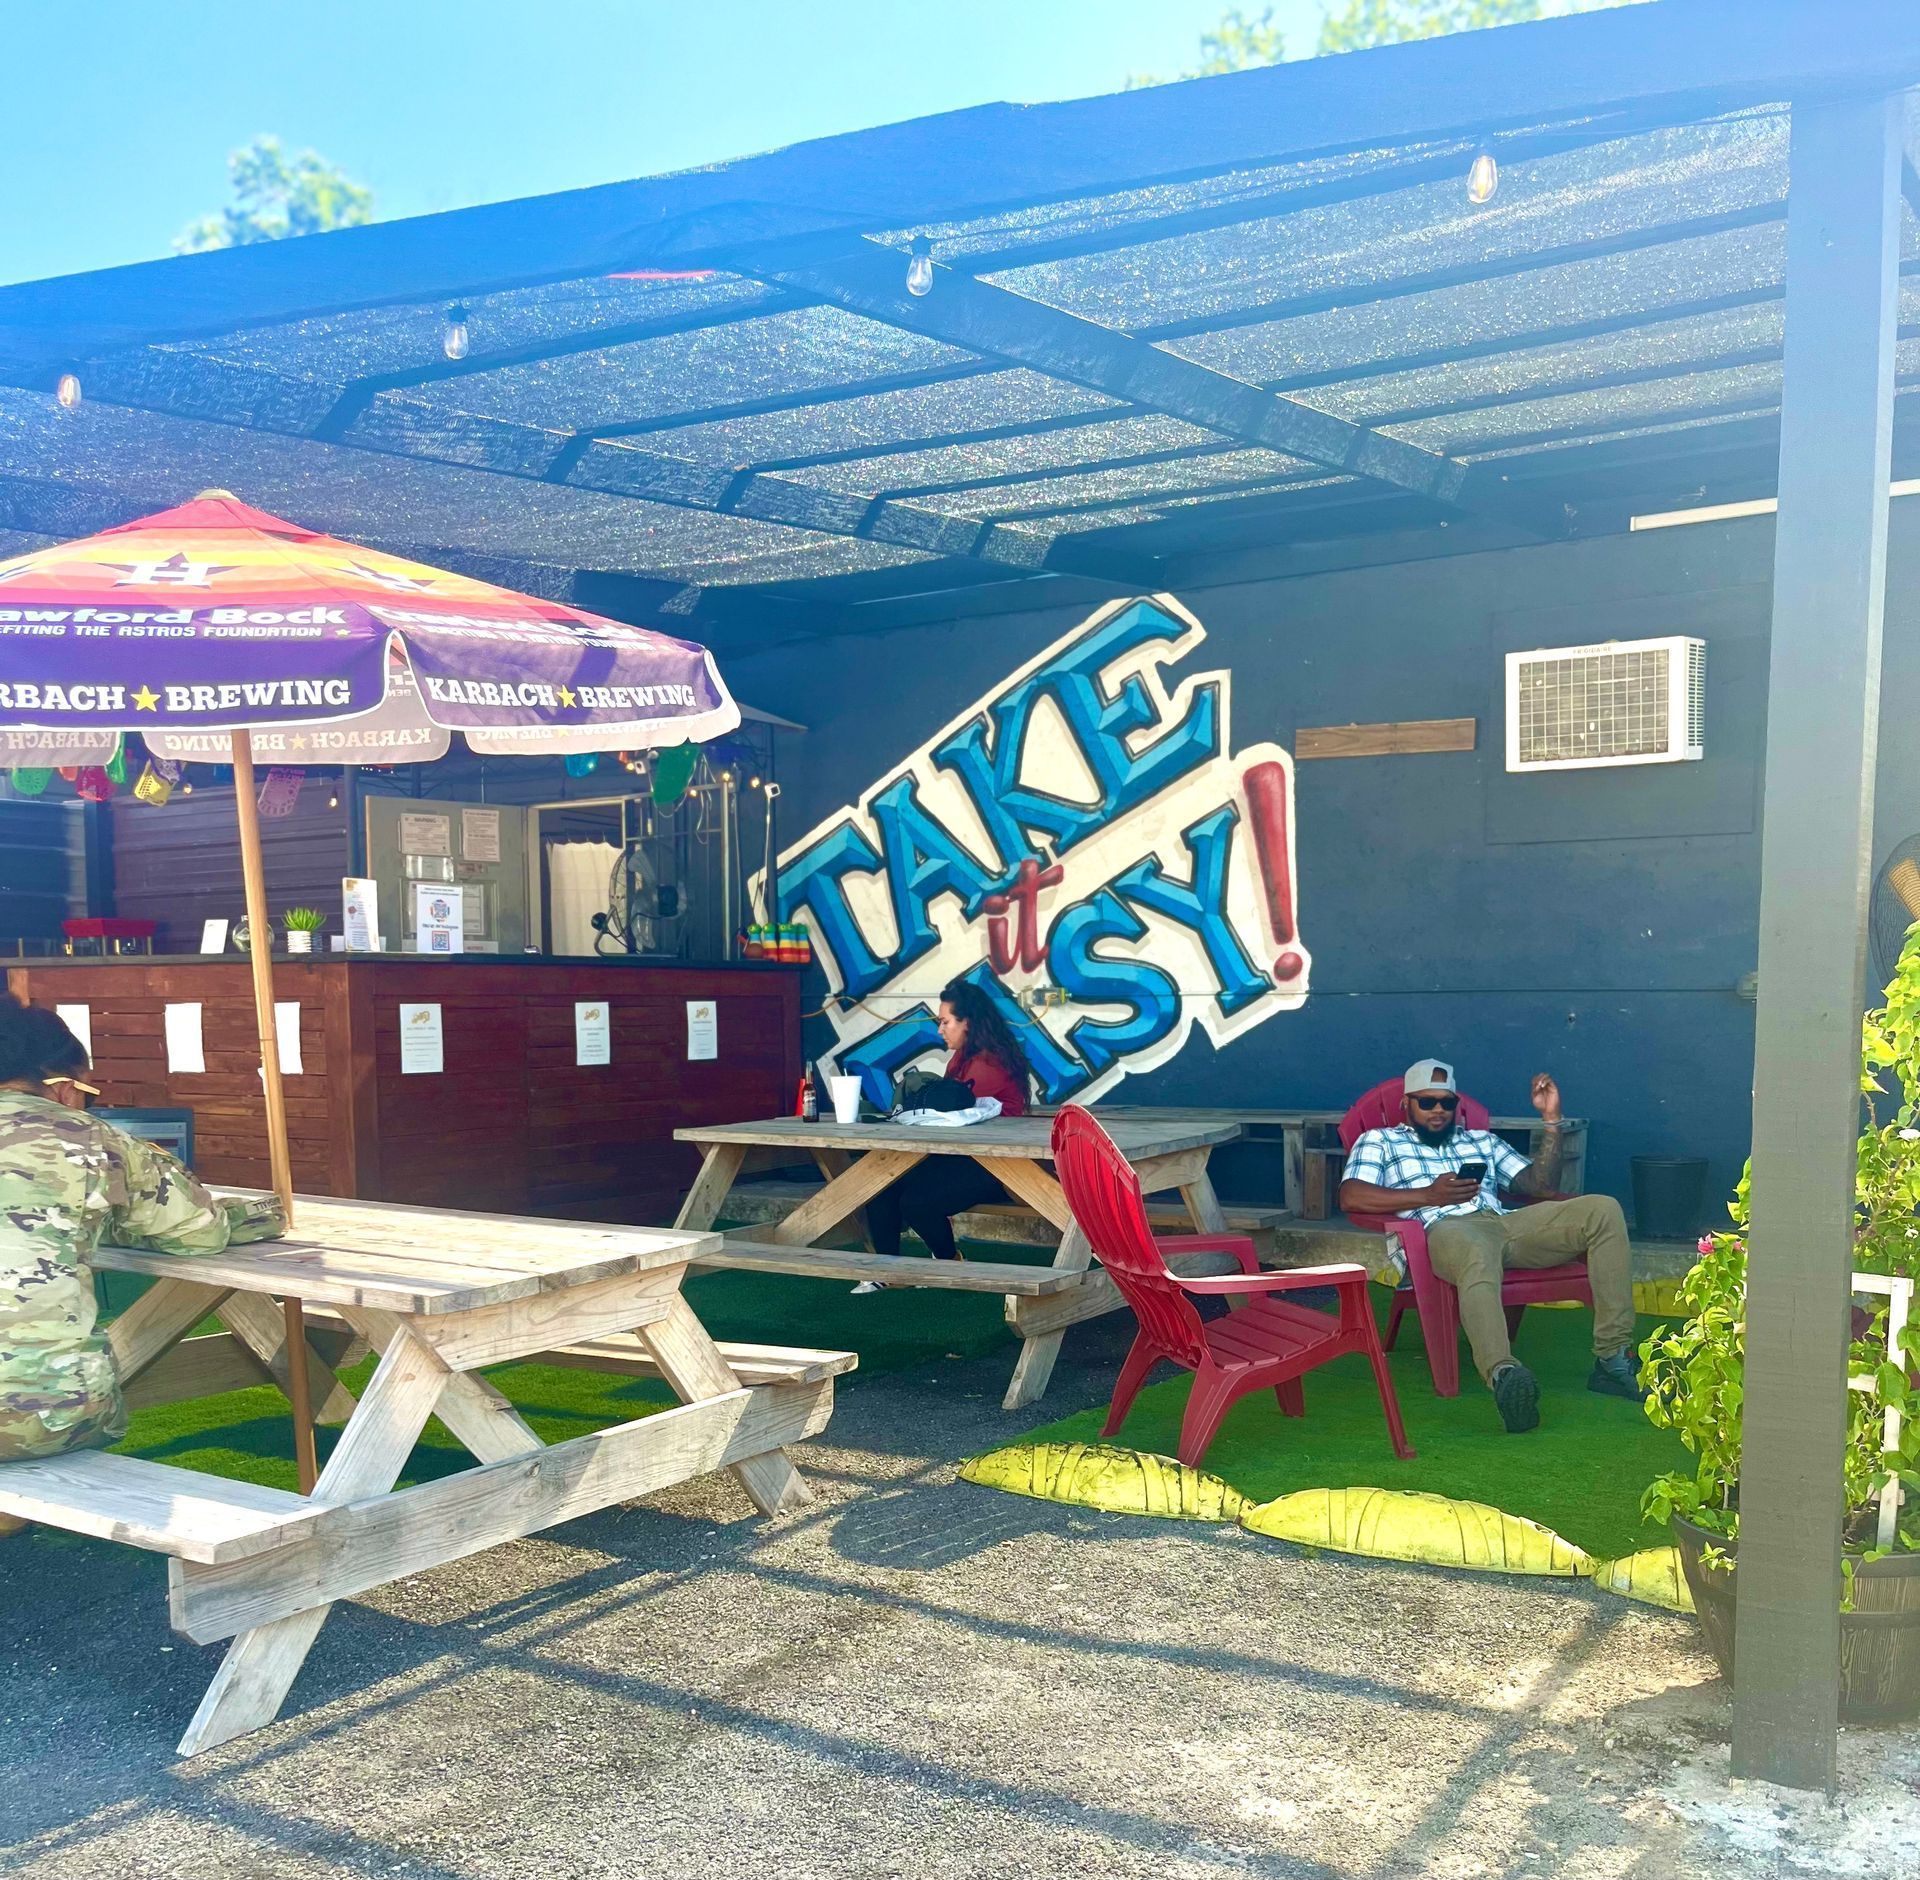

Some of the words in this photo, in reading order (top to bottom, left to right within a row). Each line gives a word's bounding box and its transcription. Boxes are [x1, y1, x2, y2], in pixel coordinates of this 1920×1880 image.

[212, 607, 346, 624] Bock
[75, 626, 111, 636] THE
[119, 626, 196, 637] ASTROS
[203, 626, 322, 638] FOUNDATION
[165, 680, 351, 711] BREWING
[425, 677, 557, 707] KARBACH
[577, 684, 697, 708] BREWING
[775, 596, 1222, 1008] TAKE
[982, 859, 1064, 975] it
